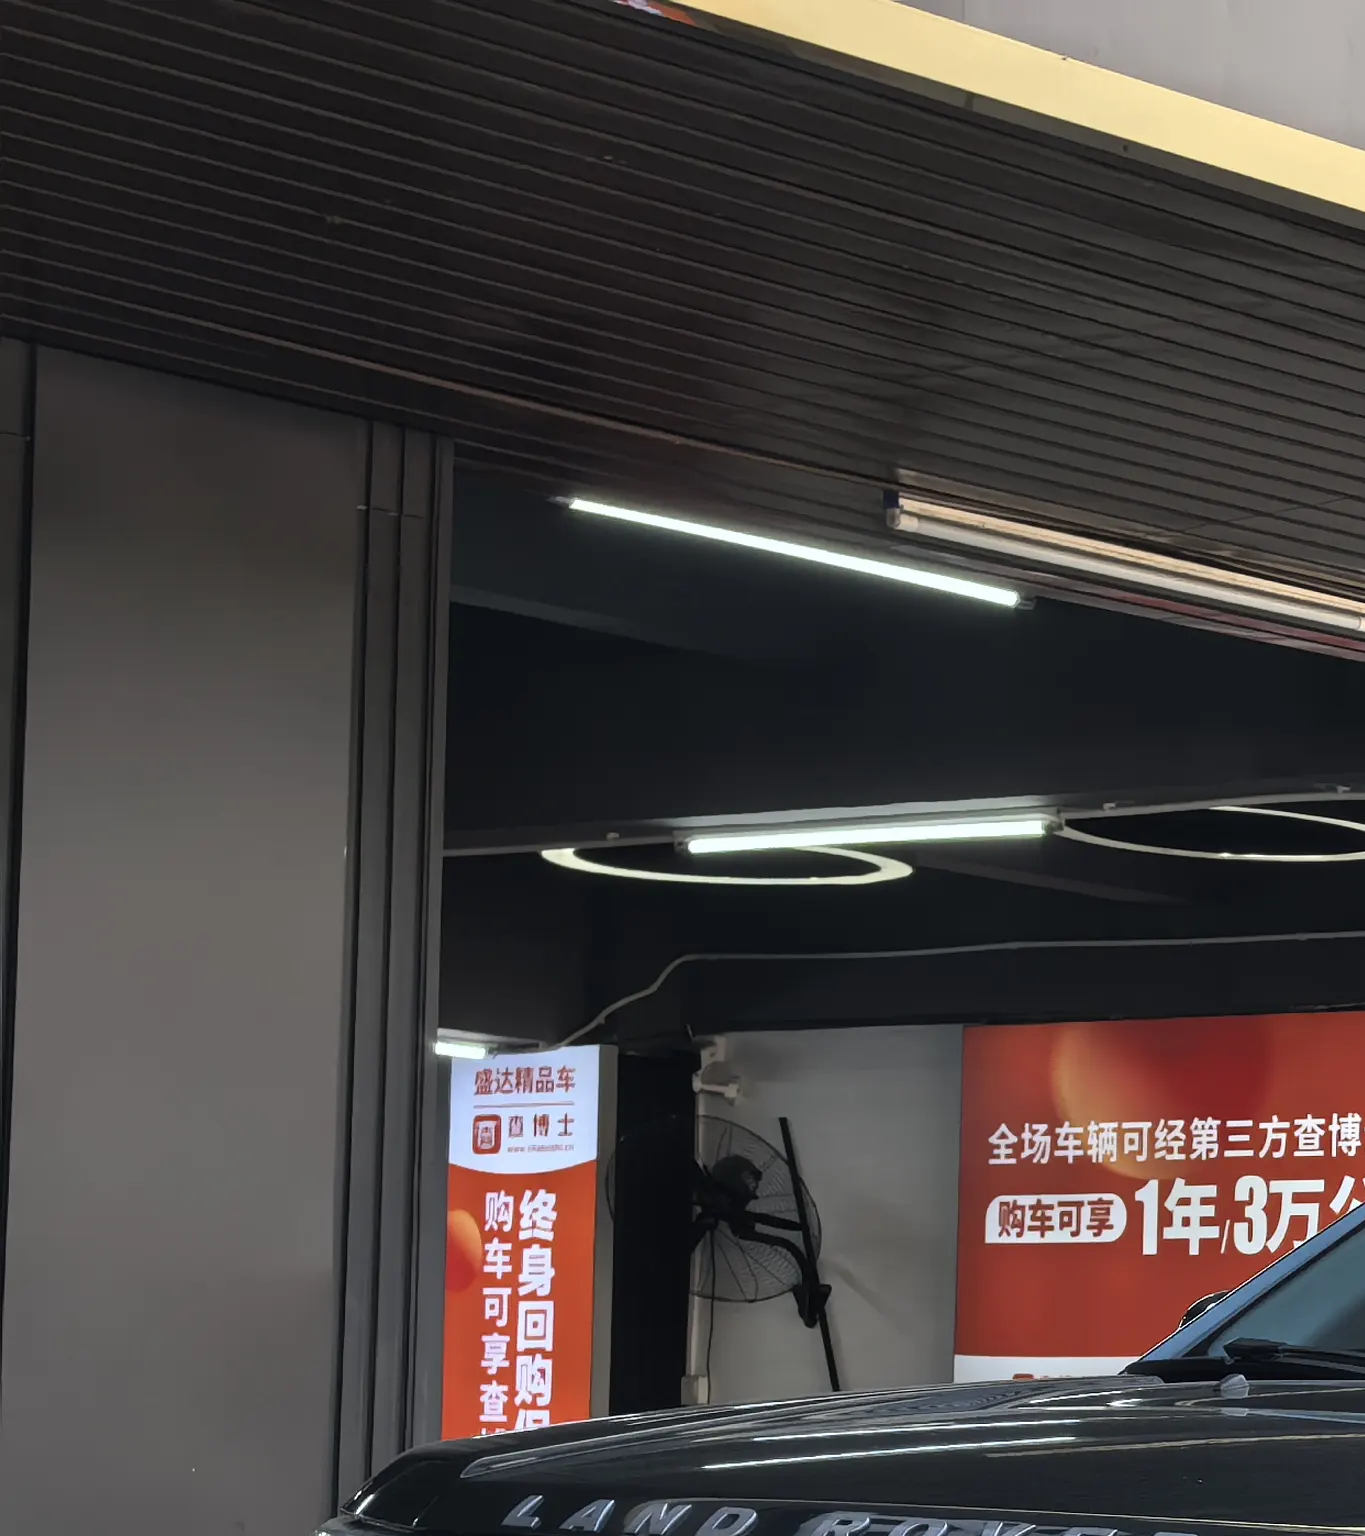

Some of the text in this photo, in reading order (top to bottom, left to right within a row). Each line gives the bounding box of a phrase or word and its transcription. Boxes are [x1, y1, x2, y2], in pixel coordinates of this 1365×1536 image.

[474, 1065, 576, 1096] 盛达精品车
[998, 1198, 1115, 1239] 购车可享
[479, 1190, 514, 1436] 购车可享查
